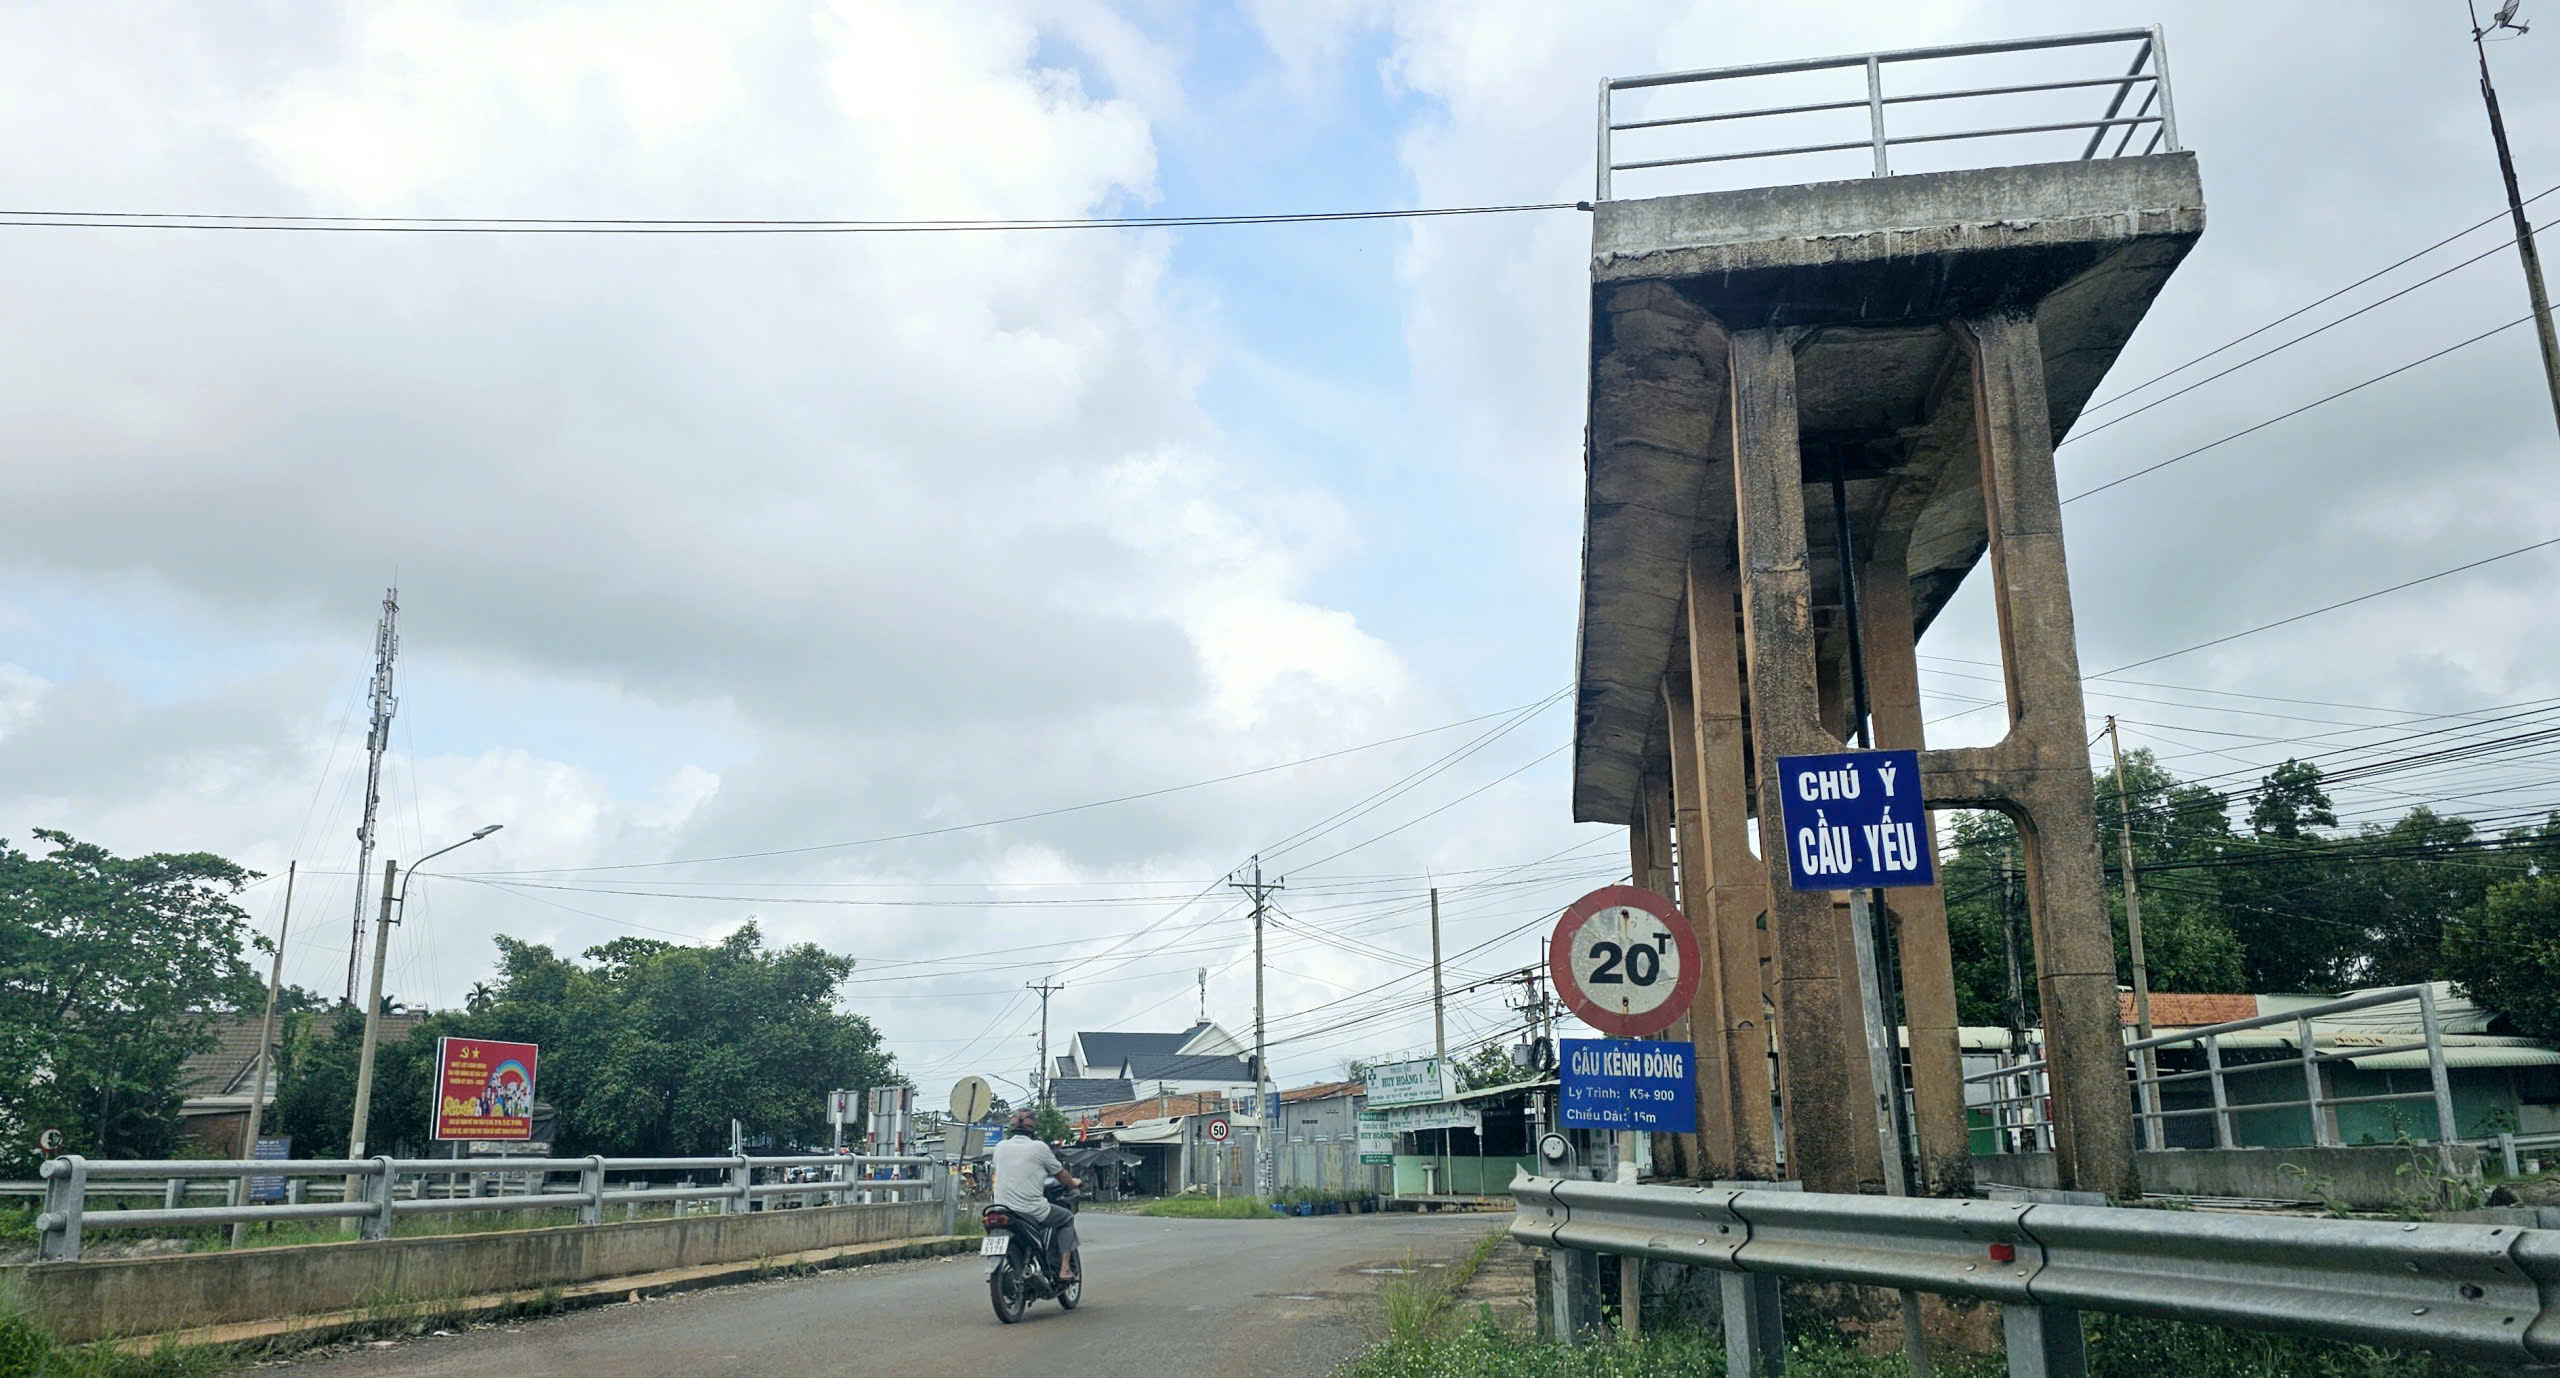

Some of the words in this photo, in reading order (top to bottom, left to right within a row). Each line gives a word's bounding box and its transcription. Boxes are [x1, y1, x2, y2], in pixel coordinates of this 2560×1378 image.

[1798, 762, 1861, 801] CHÚ
[1877, 760, 1897, 797] Ý
[1798, 808, 1853, 876] CẦU
[1863, 805, 1918, 872] YẾU
[1603, 1047, 1641, 1077] KÊNH
[1643, 1047, 1684, 1079] ĐÔNG
[1654, 1089, 1675, 1101] 900
[1633, 1111, 1657, 1123] 15m
[1213, 1125, 1225, 1136] 50
